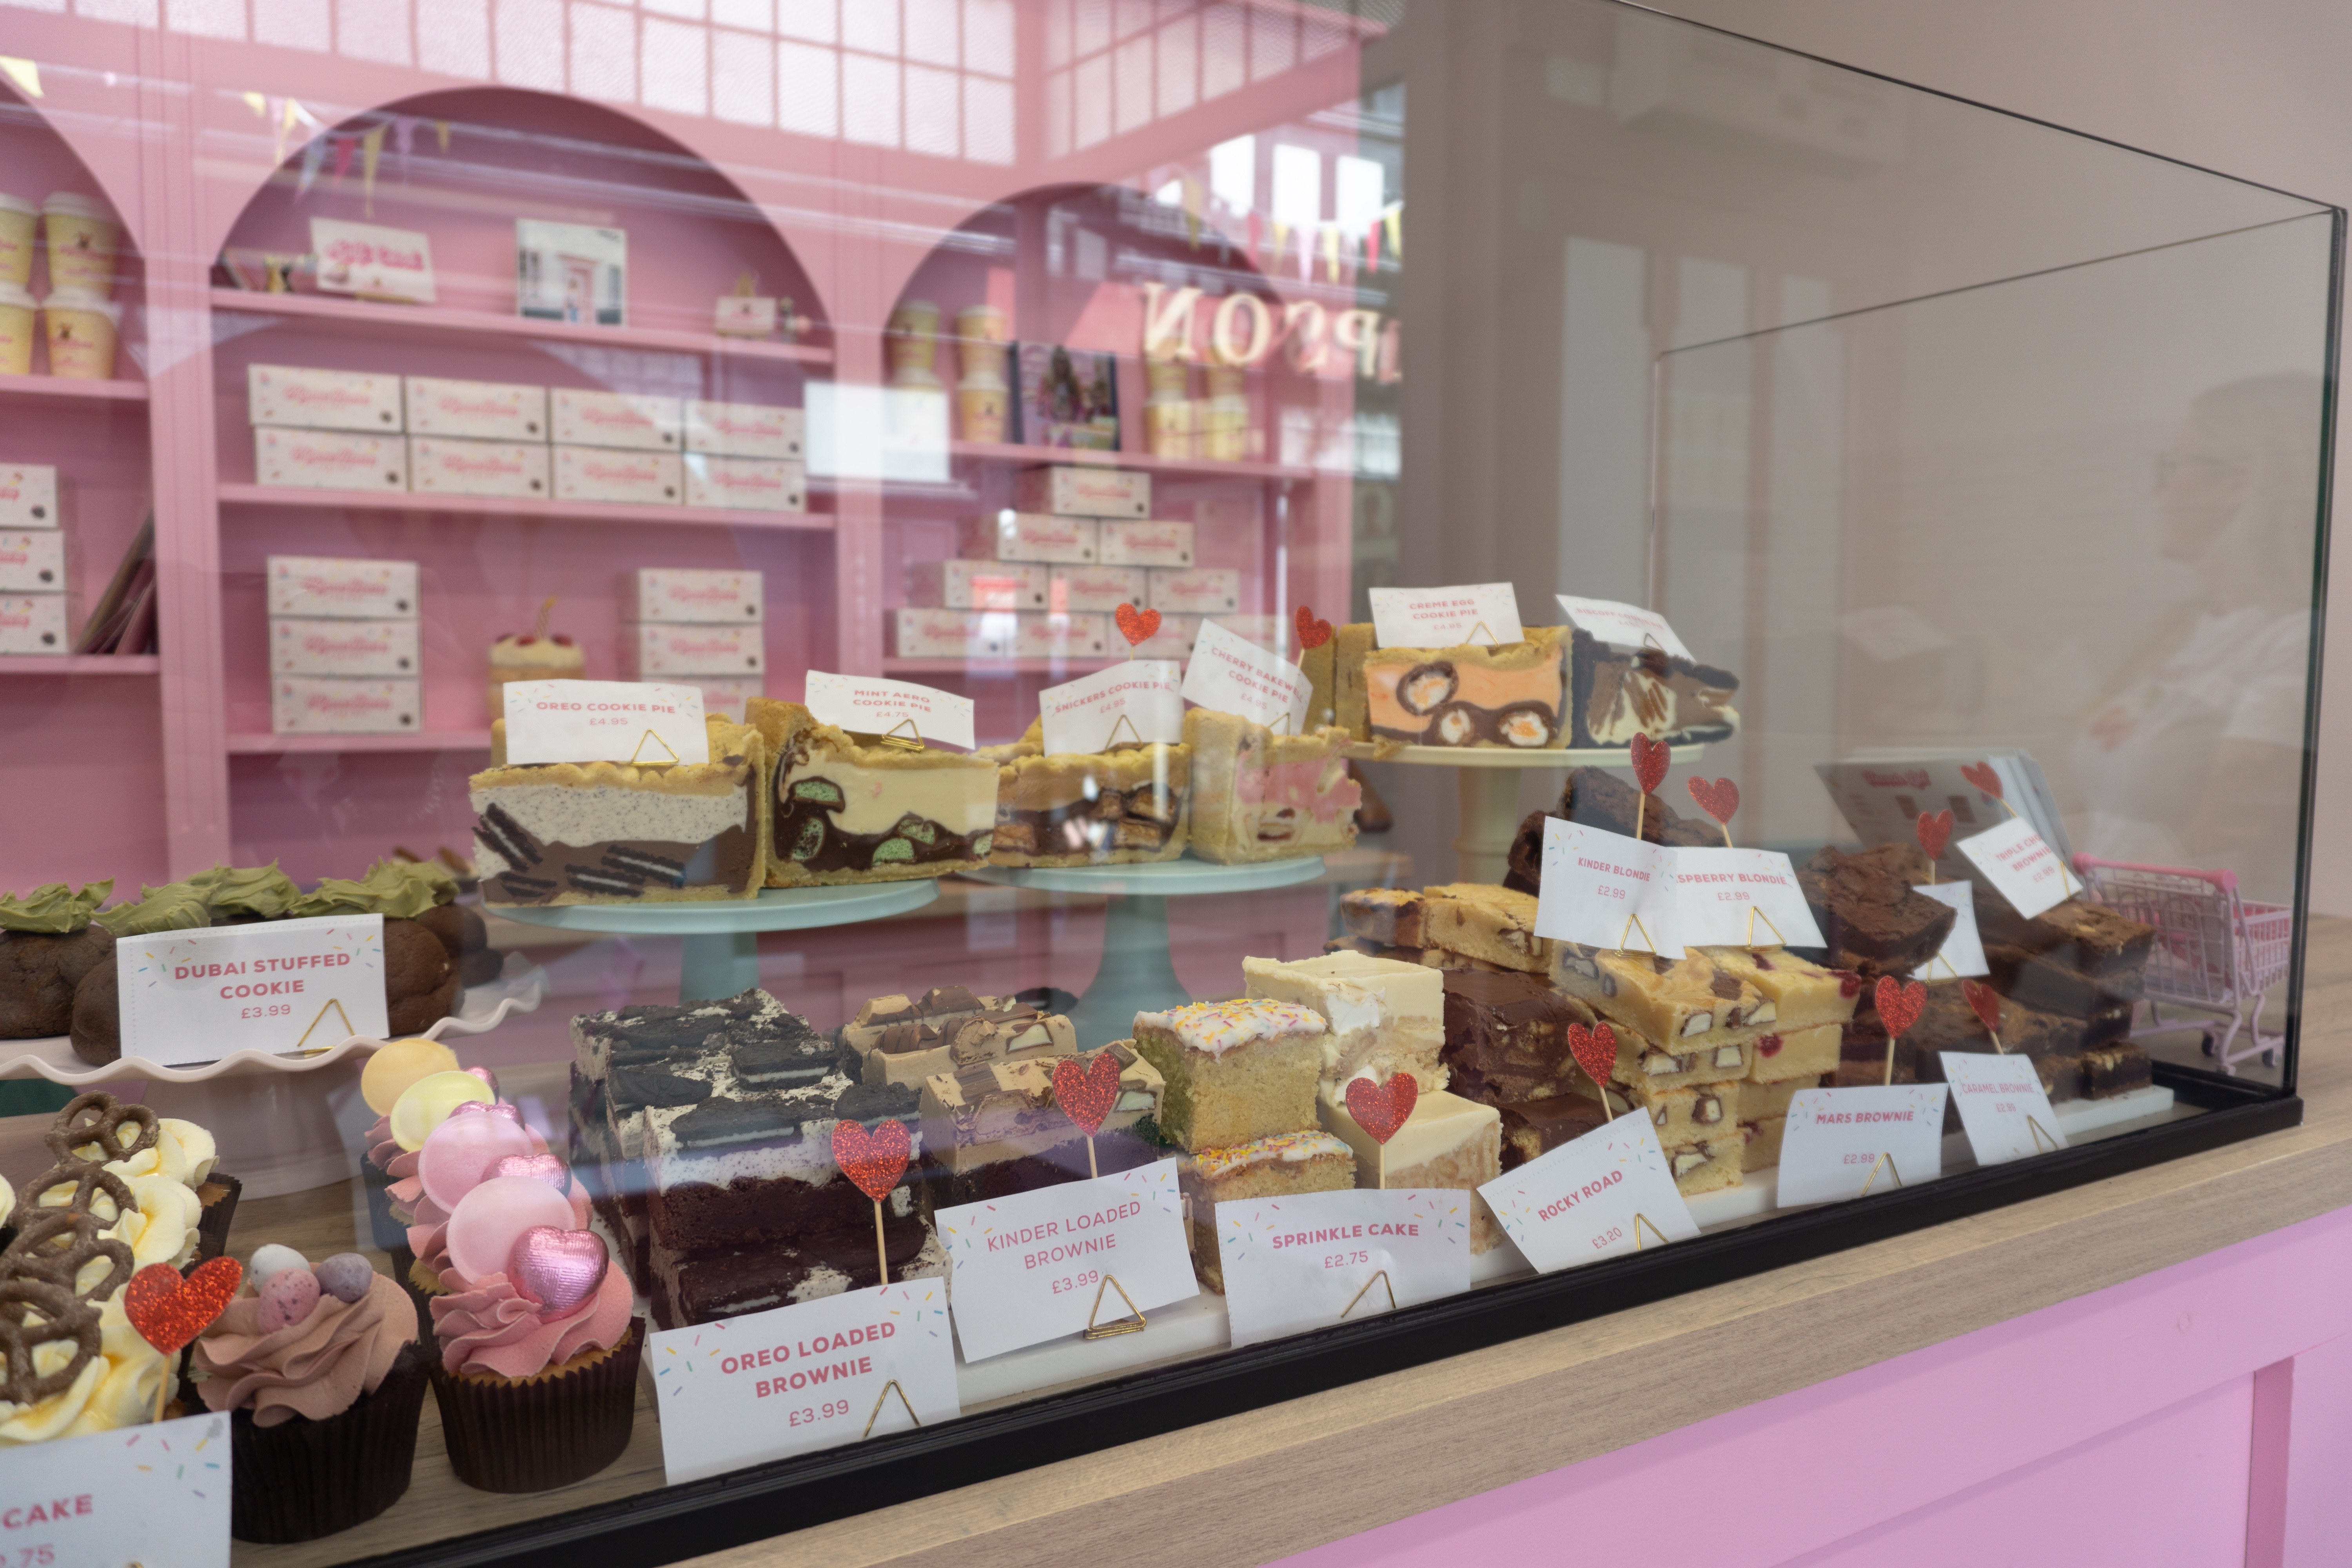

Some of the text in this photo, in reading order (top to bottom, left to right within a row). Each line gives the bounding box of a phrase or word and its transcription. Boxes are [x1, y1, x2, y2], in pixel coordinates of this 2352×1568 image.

[1409, 601, 1448, 609] CREME
[1413, 611, 1456, 619] COOKIE
[1576, 608, 1616, 617] BISCOFF
[1211, 648, 1254, 671] CHERRY
[1229, 670, 1288, 703] COOKIE PIE
[537, 702, 581, 711] OREO
[652, 705, 675, 713] PIE
[893, 693, 930, 702] AERO
[911, 703, 931, 712] PIE
[1055, 691, 1105, 713] SNICKERS
[1108, 682, 1149, 694] COOKIE
[1996, 834, 2041, 862] TRIPLE CHO
[2012, 846, 2052, 871] BROWNIE
[1578, 857, 1650, 882] KINDER BLONDIE
[1676, 873, 1787, 885] SPBERRY BLONDIE
[2033, 866, 2054, 882] £2.99
[1598, 885, 1626, 899] £2.99
[1718, 892, 1750, 900] £2.99
[174, 953, 350, 980] DUBAI STUFFED
[220, 980, 305, 1000] COOKIE
[241, 1004, 291, 1019] £3.99
[1962, 1083, 2034, 1094] CARAMEL BROWNIE
[1816, 1111, 1914, 1124] MARS BROWNIE
[1996, 1103, 2016, 1112] £2.99
[1844, 1154, 1875, 1164] £2.99
[1538, 1171, 1622, 1221] ROCKY ROAD
[987, 1201, 1140, 1252] KINDER LOADED
[1272, 1223, 1419, 1249] SPRINKLE CAKE
[1592, 1227, 1622, 1249] £3.20
[1024, 1234, 1116, 1269] BROWNIE
[1325, 1251, 1368, 1269] £2.75
[1052, 1270, 1098, 1294] £3.99
[721, 1322, 895, 1374] OREO LOADED
[756, 1356, 872, 1398] BROWNIE
[789, 1400, 849, 1426] £3.99
[2, 1493, 93, 1530] CAKE
